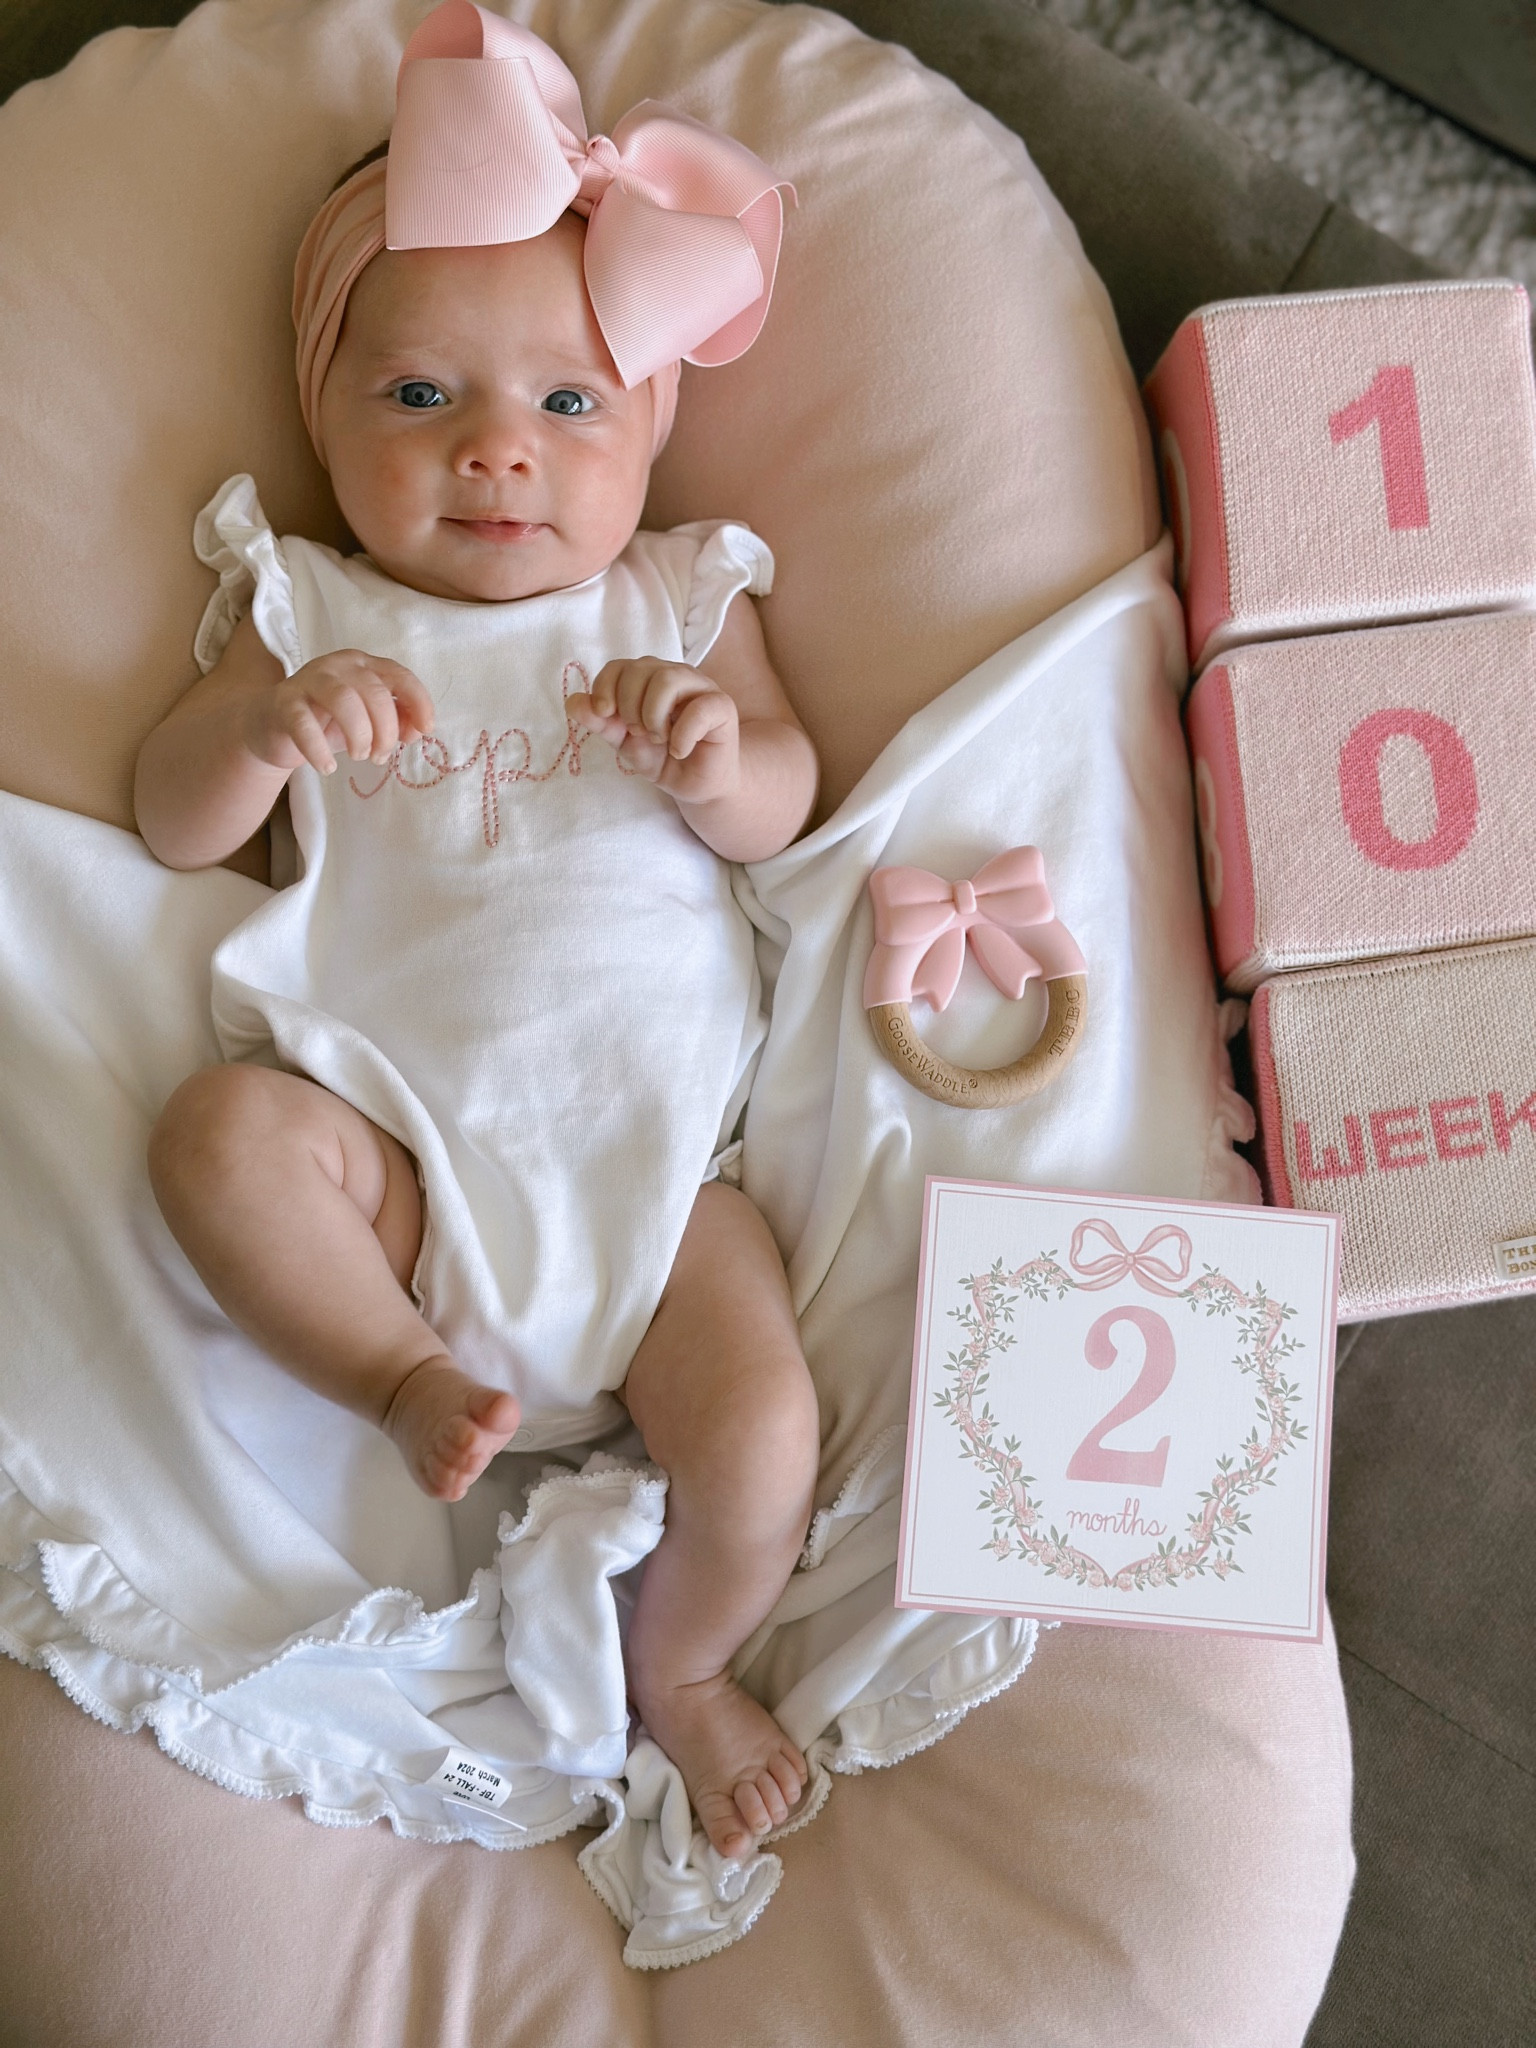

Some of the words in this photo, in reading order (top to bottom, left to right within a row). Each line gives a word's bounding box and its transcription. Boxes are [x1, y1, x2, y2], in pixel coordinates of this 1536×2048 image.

[1328, 364, 1430, 531] 1
[1338, 708, 1480, 872] 0
[1066, 1305, 1176, 1487] 2
[1066, 1497, 1167, 1536] months
[443, 1773, 456, 1782] 24
[457, 1762, 476, 1776] 2024
[457, 1777, 476, 1792] FALL
[478, 1770, 501, 1787] March
[479, 1788, 496, 1801] TBF
